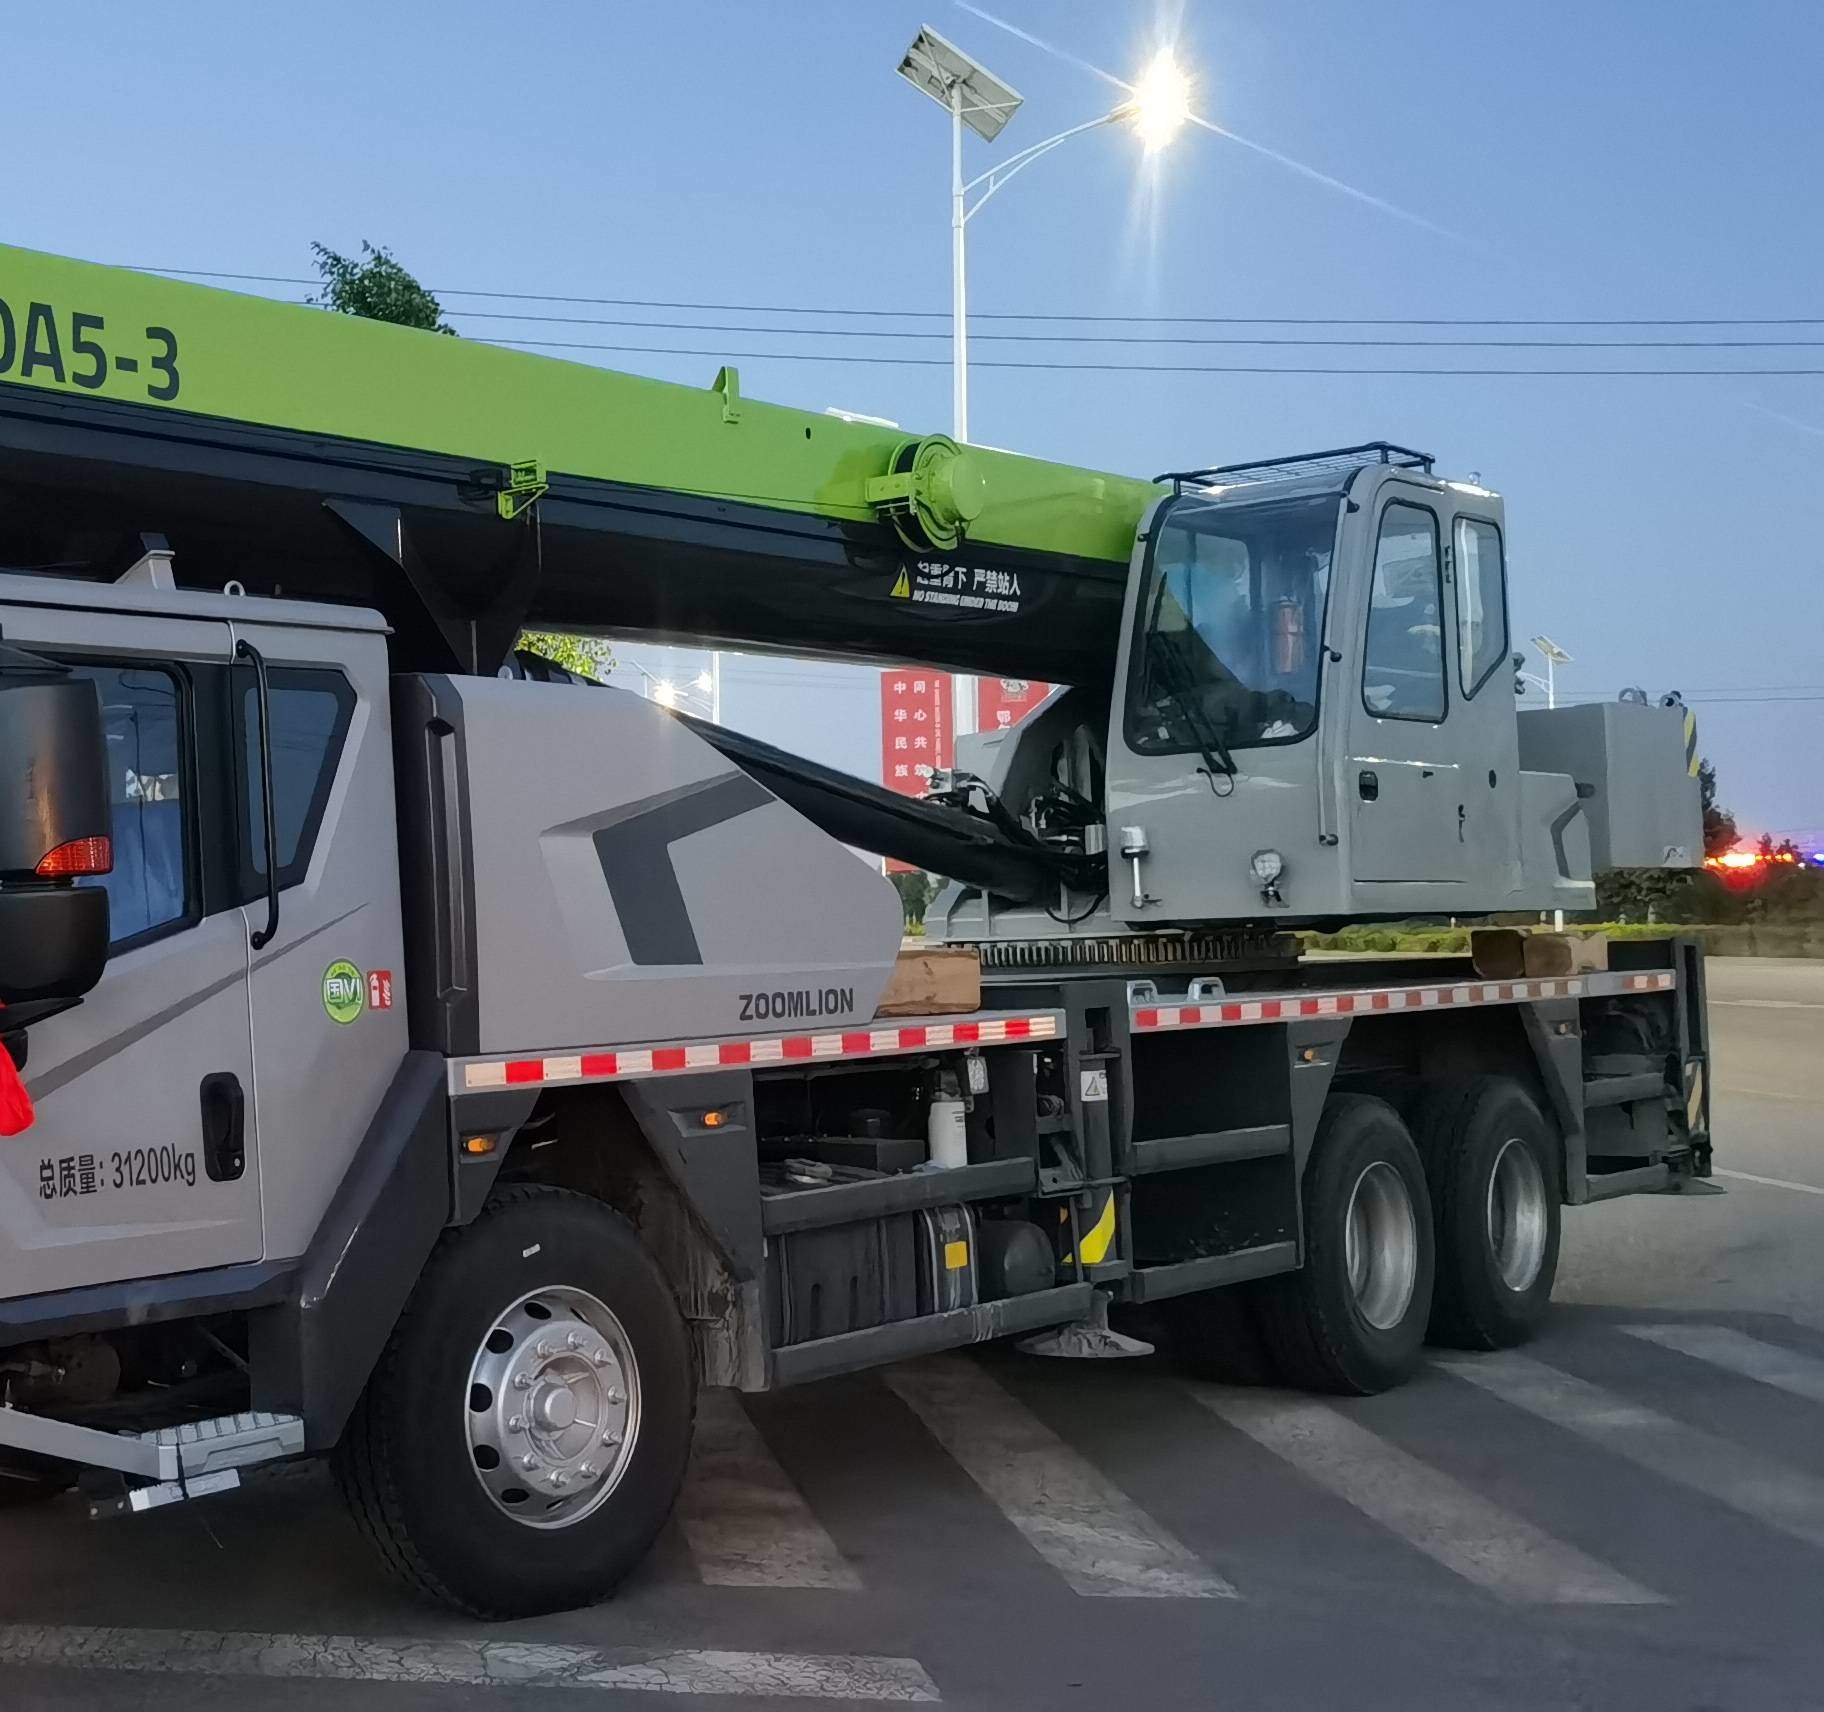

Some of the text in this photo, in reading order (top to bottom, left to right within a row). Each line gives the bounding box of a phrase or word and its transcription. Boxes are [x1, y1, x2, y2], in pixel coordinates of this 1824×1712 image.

[973, 568, 1021, 596] 严禁站人
[738, 987, 854, 1021] ZOOMLION
